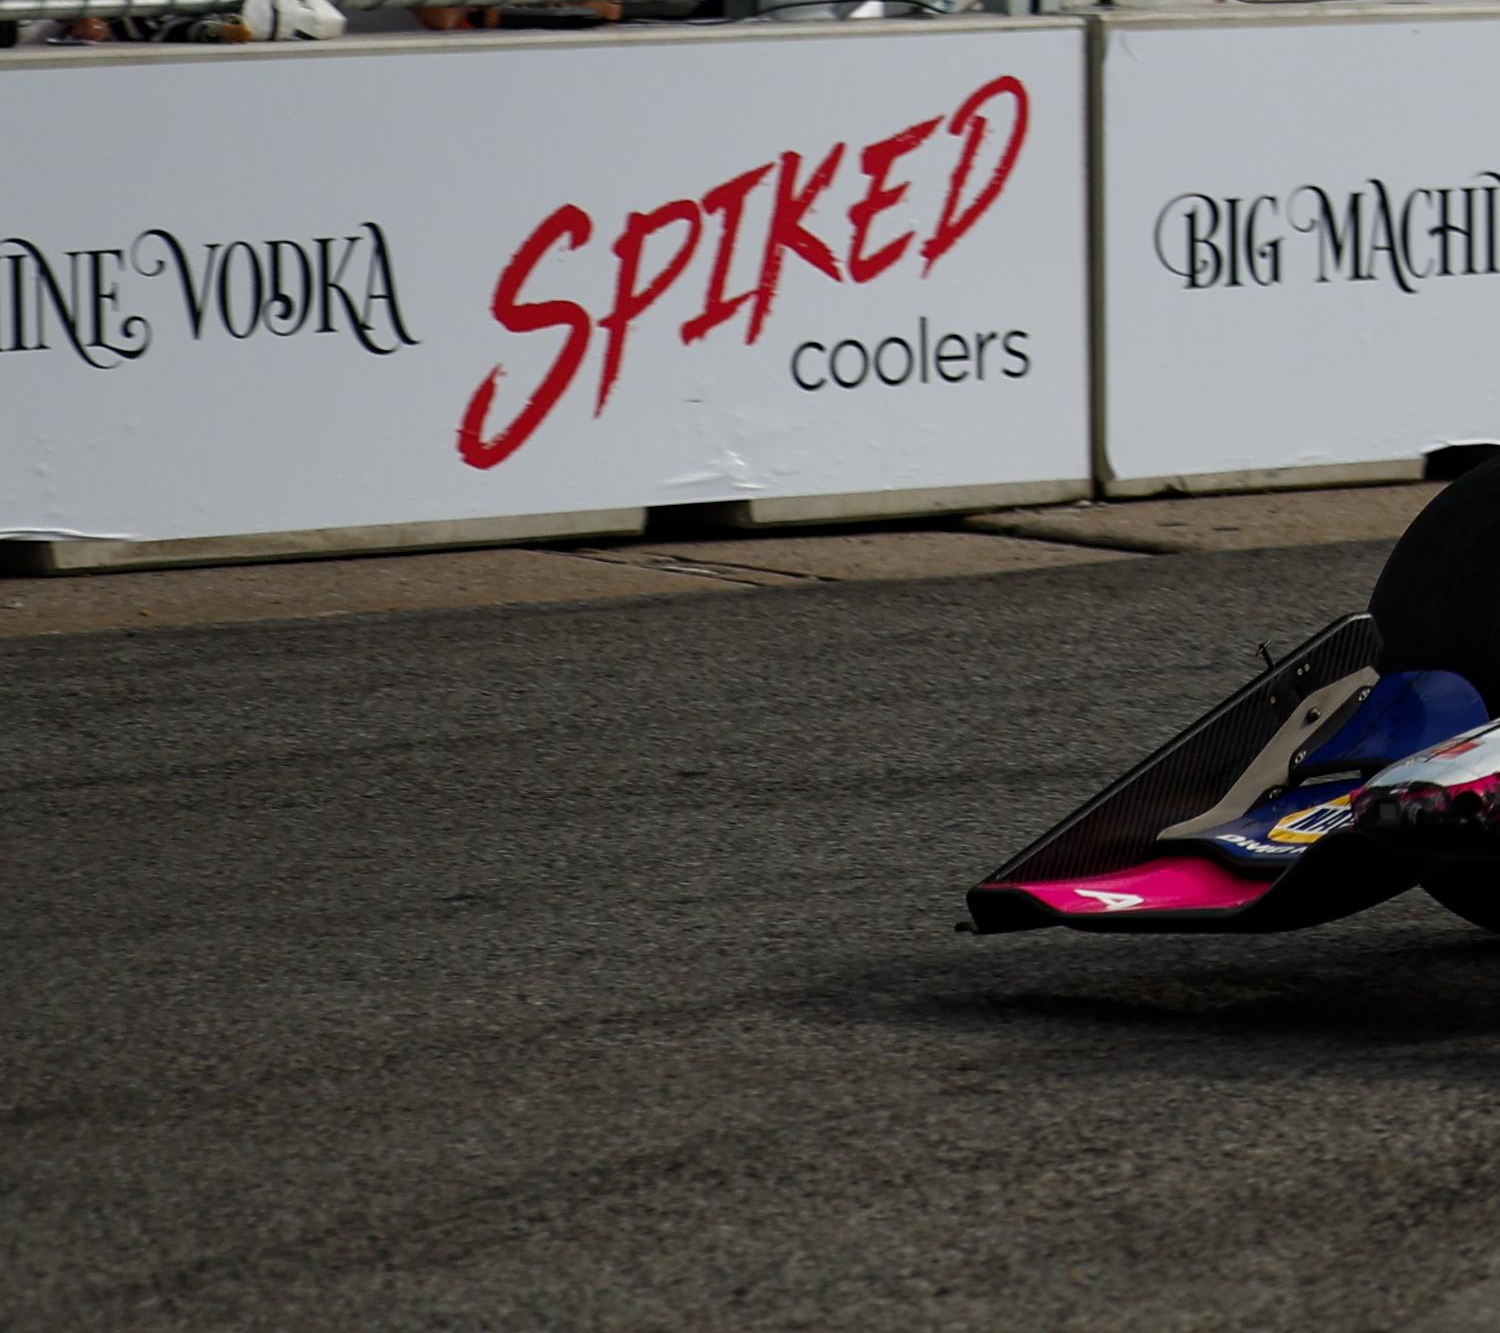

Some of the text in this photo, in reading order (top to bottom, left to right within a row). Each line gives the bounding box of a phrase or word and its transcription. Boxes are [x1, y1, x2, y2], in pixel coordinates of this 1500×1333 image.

[131, 222, 420, 354] VODKA
[456, 75, 1030, 469] SPIKED
[1154, 190, 1284, 290] BIG
[791, 316, 1030, 391] coolers
